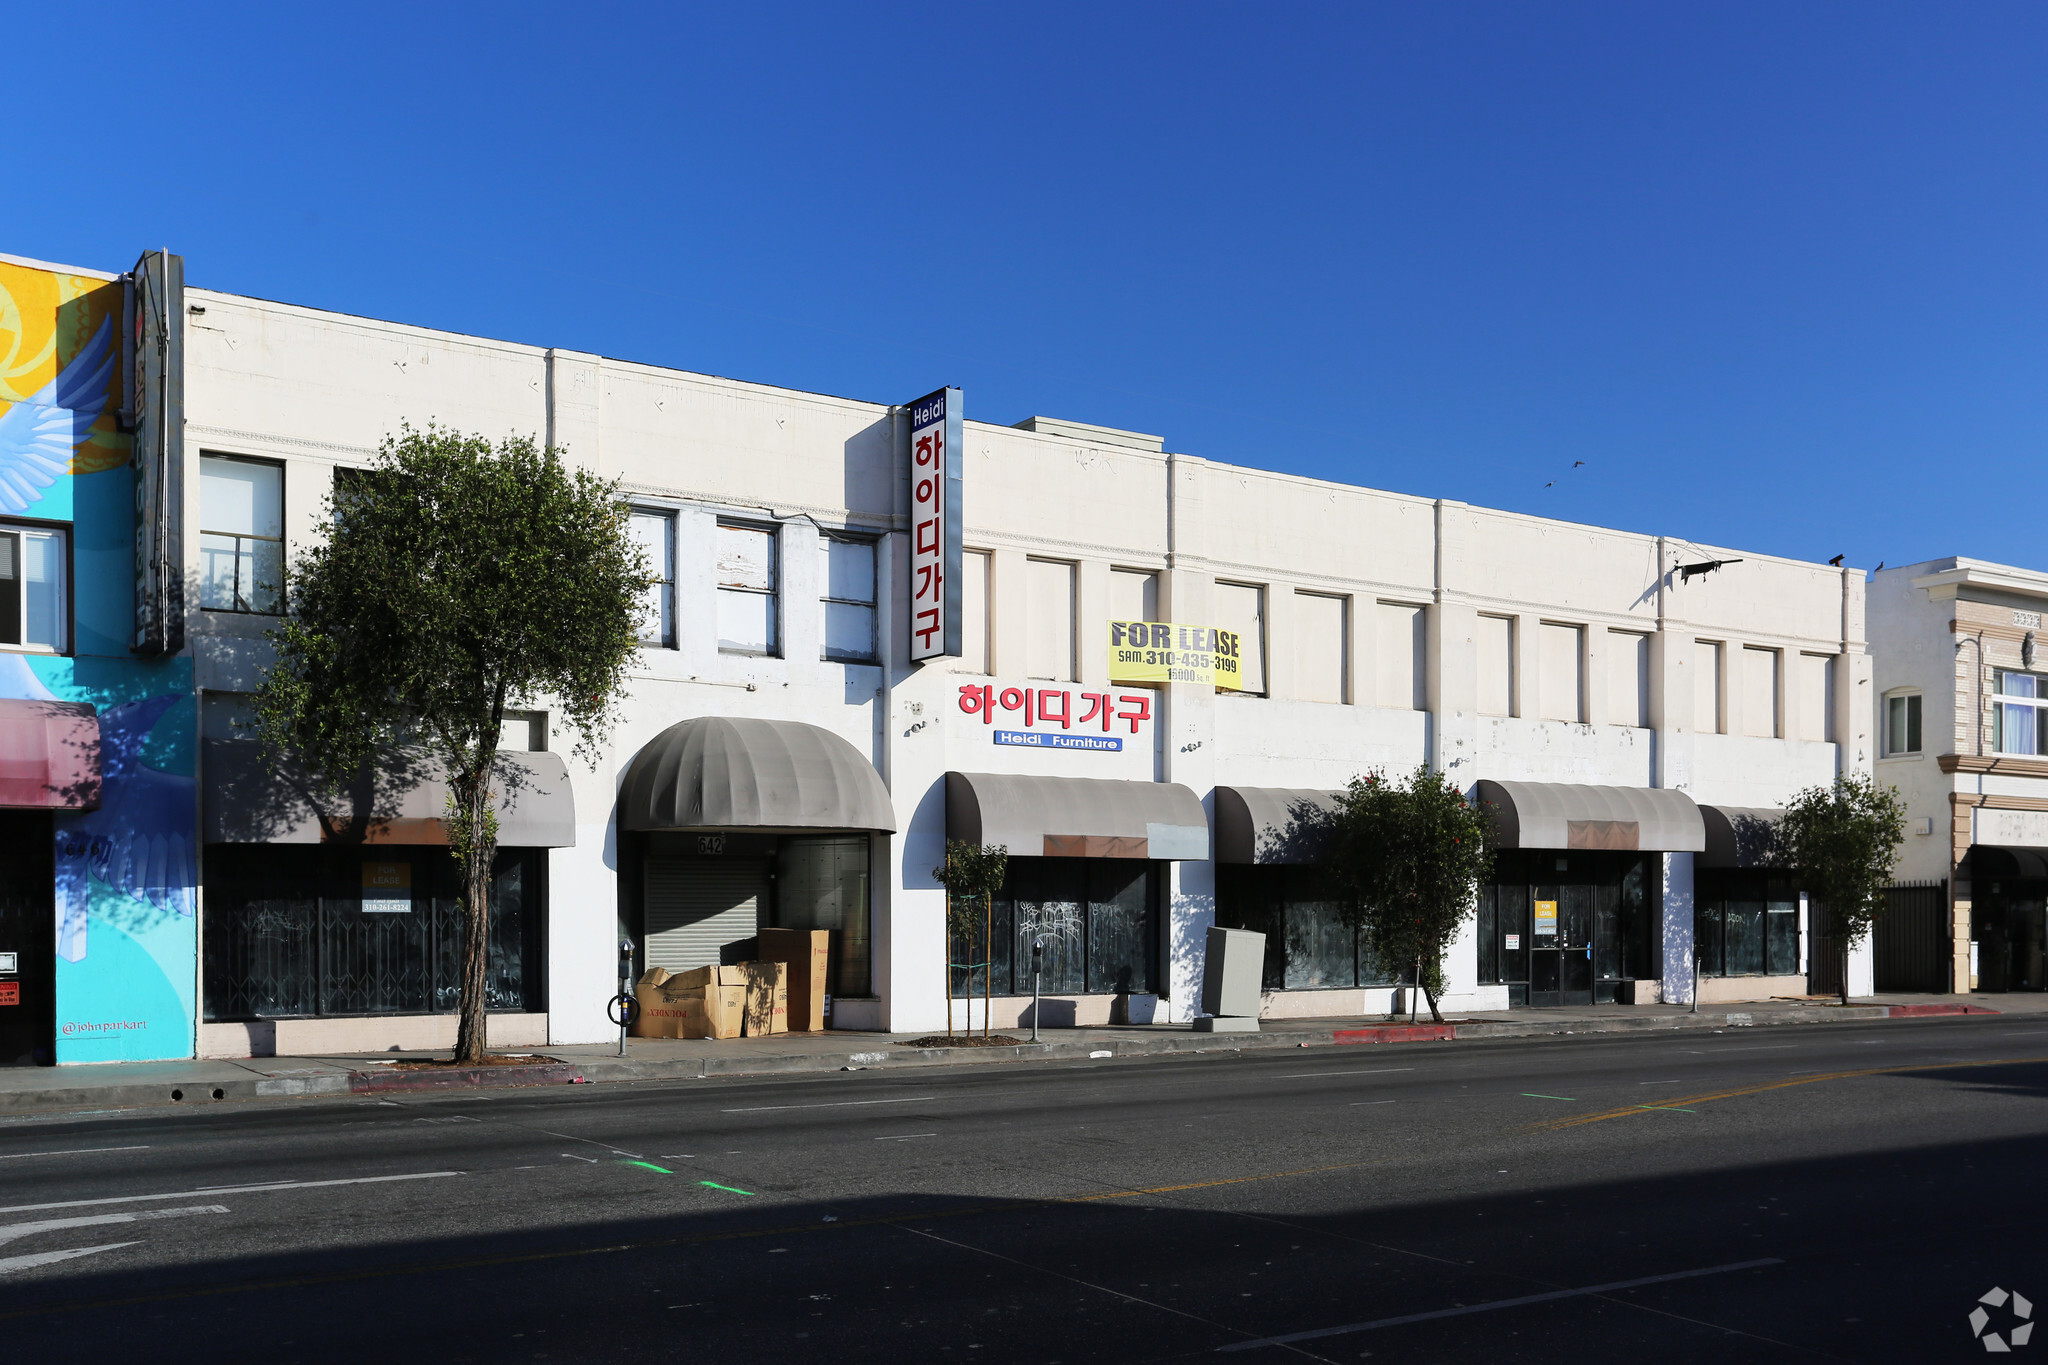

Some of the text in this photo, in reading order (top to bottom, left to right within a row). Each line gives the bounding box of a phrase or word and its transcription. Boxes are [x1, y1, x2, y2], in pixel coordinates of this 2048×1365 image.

[914, 397, 944, 427] Heidi
[915, 430, 943, 650] 하이디가구
[1111, 622, 1239, 658] FOR LEASE
[1001, 732, 1118, 749] Heidi Furniture
[65, 841, 100, 857] 646
[700, 837, 721, 853] 642
[378, 866, 396, 874] FOR
[373, 876, 400, 884] LEASE
[649, 1008, 687, 1018] POUNDEX
